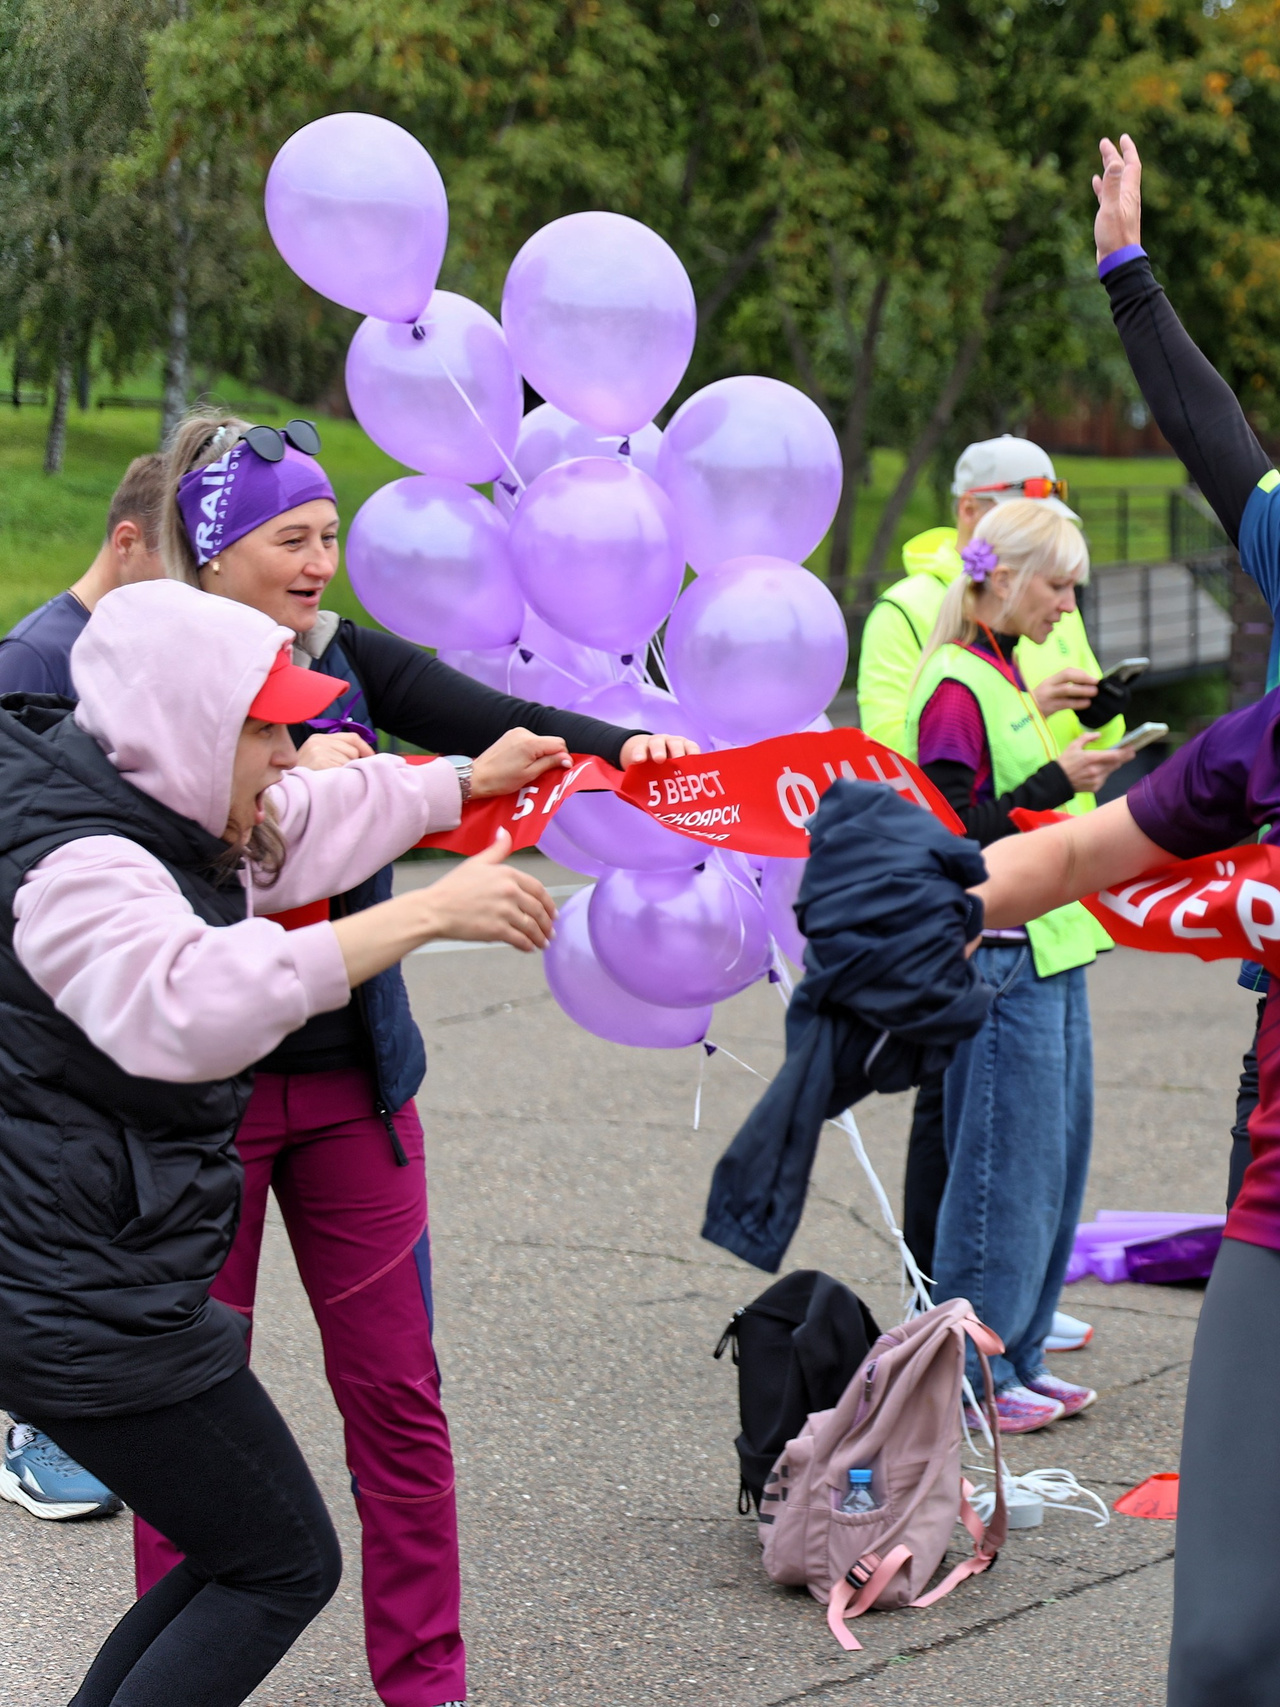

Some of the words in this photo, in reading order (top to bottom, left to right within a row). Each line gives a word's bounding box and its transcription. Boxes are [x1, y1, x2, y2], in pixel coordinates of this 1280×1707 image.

[511, 786, 539, 821] 5
[647, 780, 662, 807] 5
[663, 769, 726, 805] ВЁРСТ
[653, 803, 741, 827] СНОЯРСК
